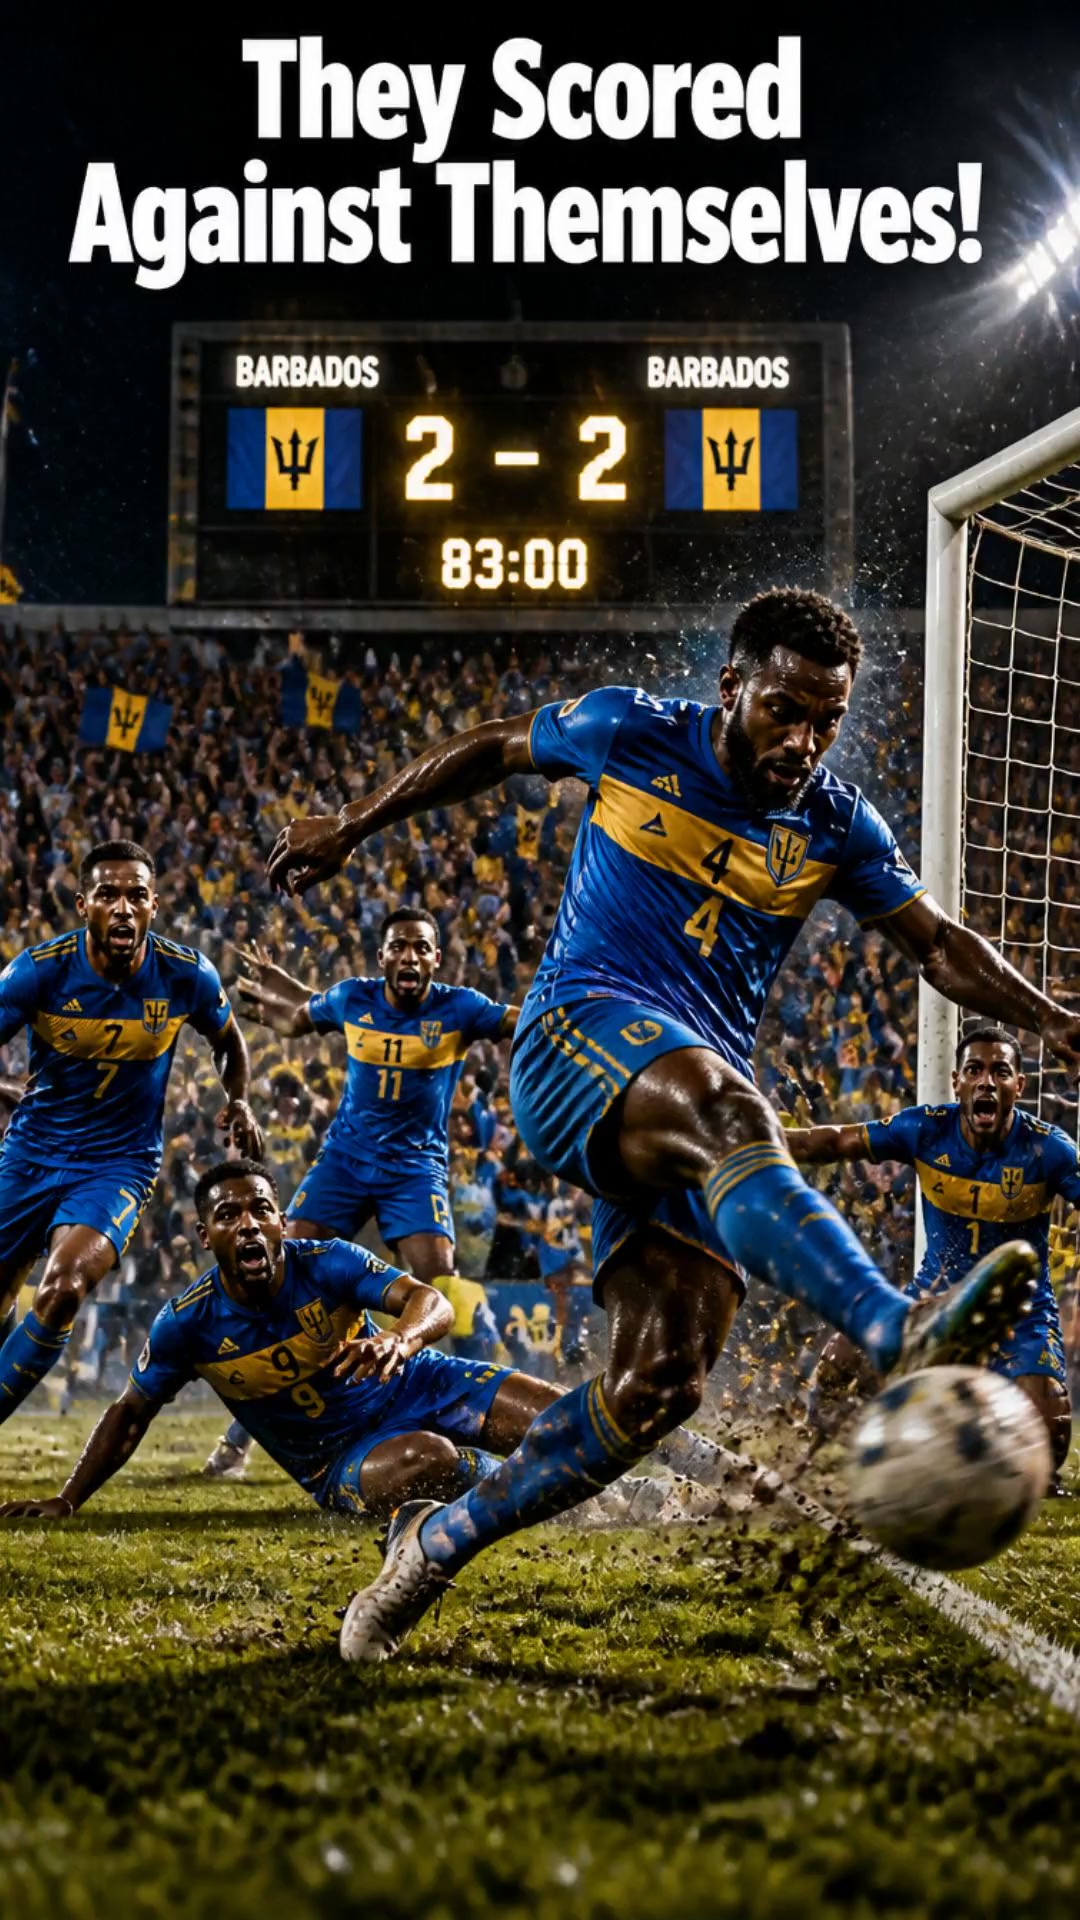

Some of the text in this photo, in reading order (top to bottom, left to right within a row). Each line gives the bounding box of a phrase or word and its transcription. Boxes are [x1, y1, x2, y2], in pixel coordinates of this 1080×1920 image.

[235, 354, 380, 389] BARBADOS
[647, 355, 790, 389] BARBADOS
[405, 415, 454, 501] 2
[578, 415, 627, 501] 2
[441, 537, 588, 590] 83:00
[701, 838, 733, 884] 4
[684, 896, 724, 957] 4
[104, 1024, 123, 1055] 7
[382, 1038, 402, 1063] 11
[93, 1062, 119, 1099] 7
[377, 1069, 402, 1100] 11
[969, 1184, 980, 1215] 1
[966, 1221, 980, 1254] 1
[271, 1346, 300, 1382] 9
[291, 1381, 326, 1419] 9
